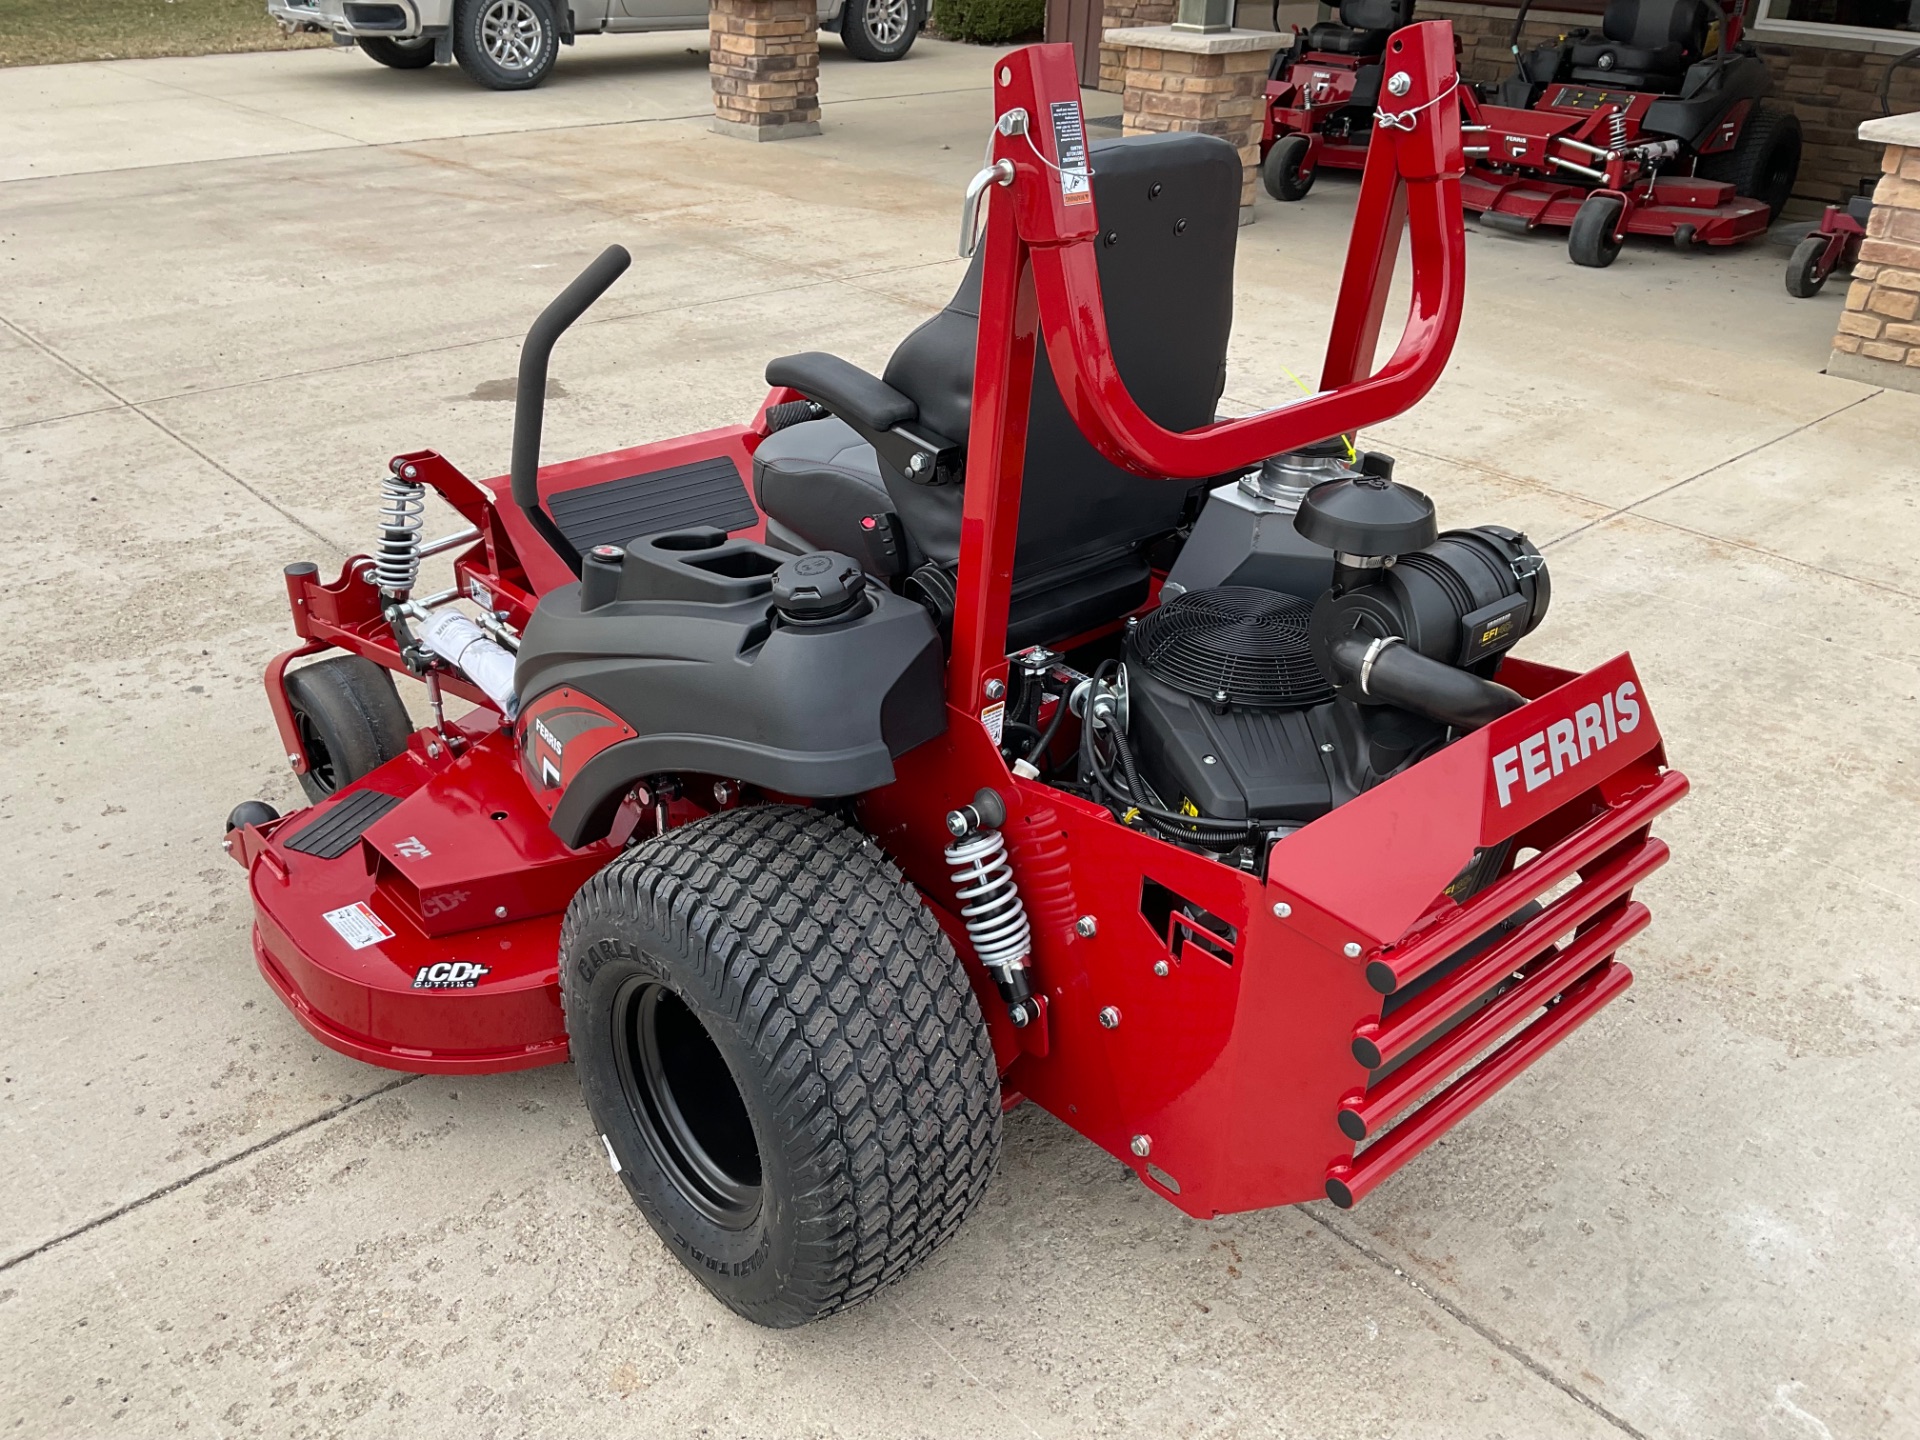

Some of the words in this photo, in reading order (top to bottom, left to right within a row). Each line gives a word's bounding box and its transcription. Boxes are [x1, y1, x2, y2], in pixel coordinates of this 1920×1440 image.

[1482, 627, 1499, 642] EFI
[535, 717, 563, 756] FERRIS
[1492, 681, 1641, 808] FERRIS
